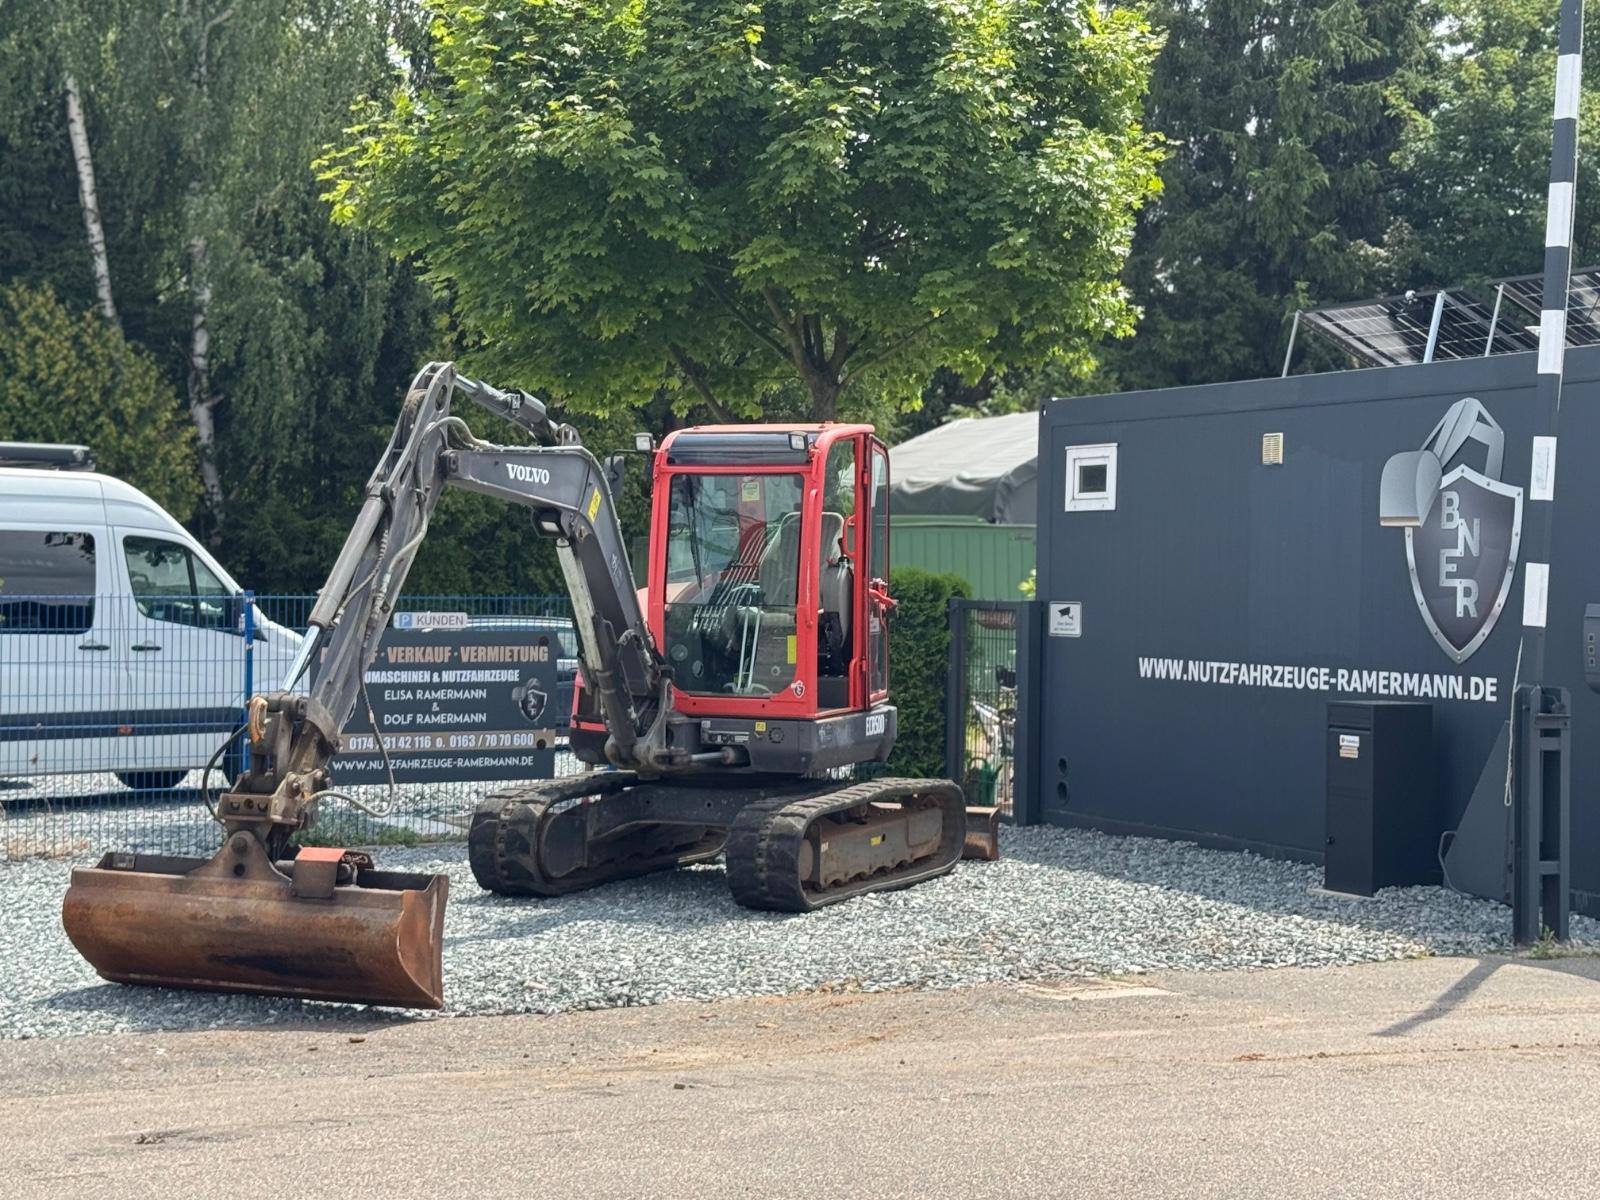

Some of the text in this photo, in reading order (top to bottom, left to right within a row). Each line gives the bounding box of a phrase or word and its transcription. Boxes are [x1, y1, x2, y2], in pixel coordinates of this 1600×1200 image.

[506, 463, 550, 485] VOLVO
[401, 615, 464, 626] P KUNDEN
[387, 646, 452, 663] VERKAUF
[460, 646, 549, 663] VERMIETUNG
[364, 669, 520, 684] UMASCHINEN & NUTZFAHRZEUGE
[1138, 657, 1498, 702] WWW.NUTZFAHRZEUGE-RAMERMANN.DE
[384, 689, 487, 700] ELISA RAMERMANN
[431, 702, 440, 712] &
[384, 713, 487, 725] DOLF RAMERMANN
[349, 737, 374, 750] 0174
[449, 734, 476, 748] 0163
[485, 734, 497, 747] 70
[499, 733, 511, 746] 70
[513, 733, 534, 746] 600
[332, 755, 534, 771] WWW.NUZFAHRZEUGE-RAMERMANN.DE
